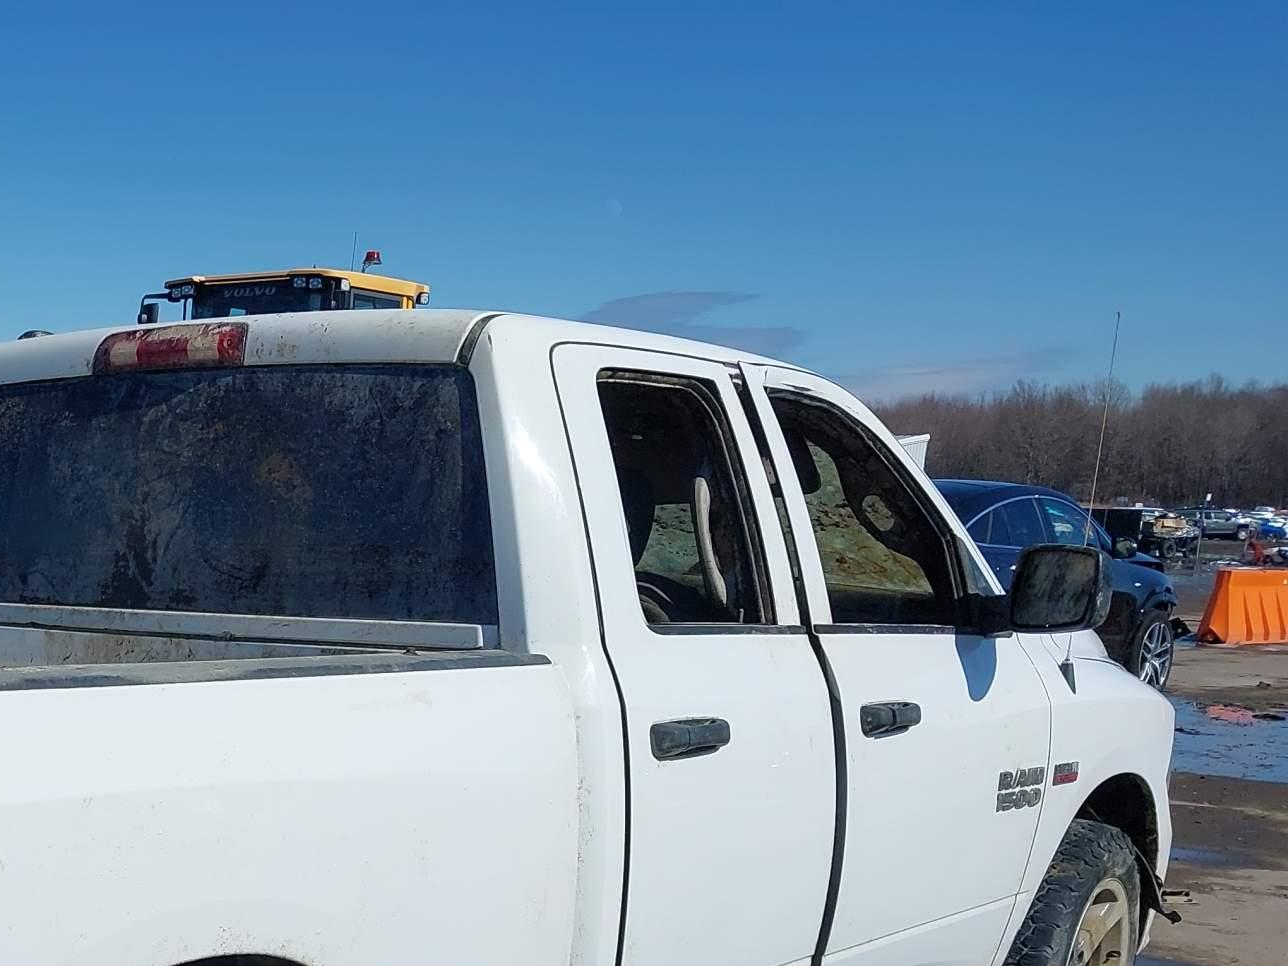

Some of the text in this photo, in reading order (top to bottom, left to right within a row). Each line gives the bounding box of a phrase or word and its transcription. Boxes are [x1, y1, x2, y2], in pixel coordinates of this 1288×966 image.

[223, 286, 276, 298] VOLVO
[997, 766, 1046, 792] RAM
[995, 787, 1042, 813] 1500
